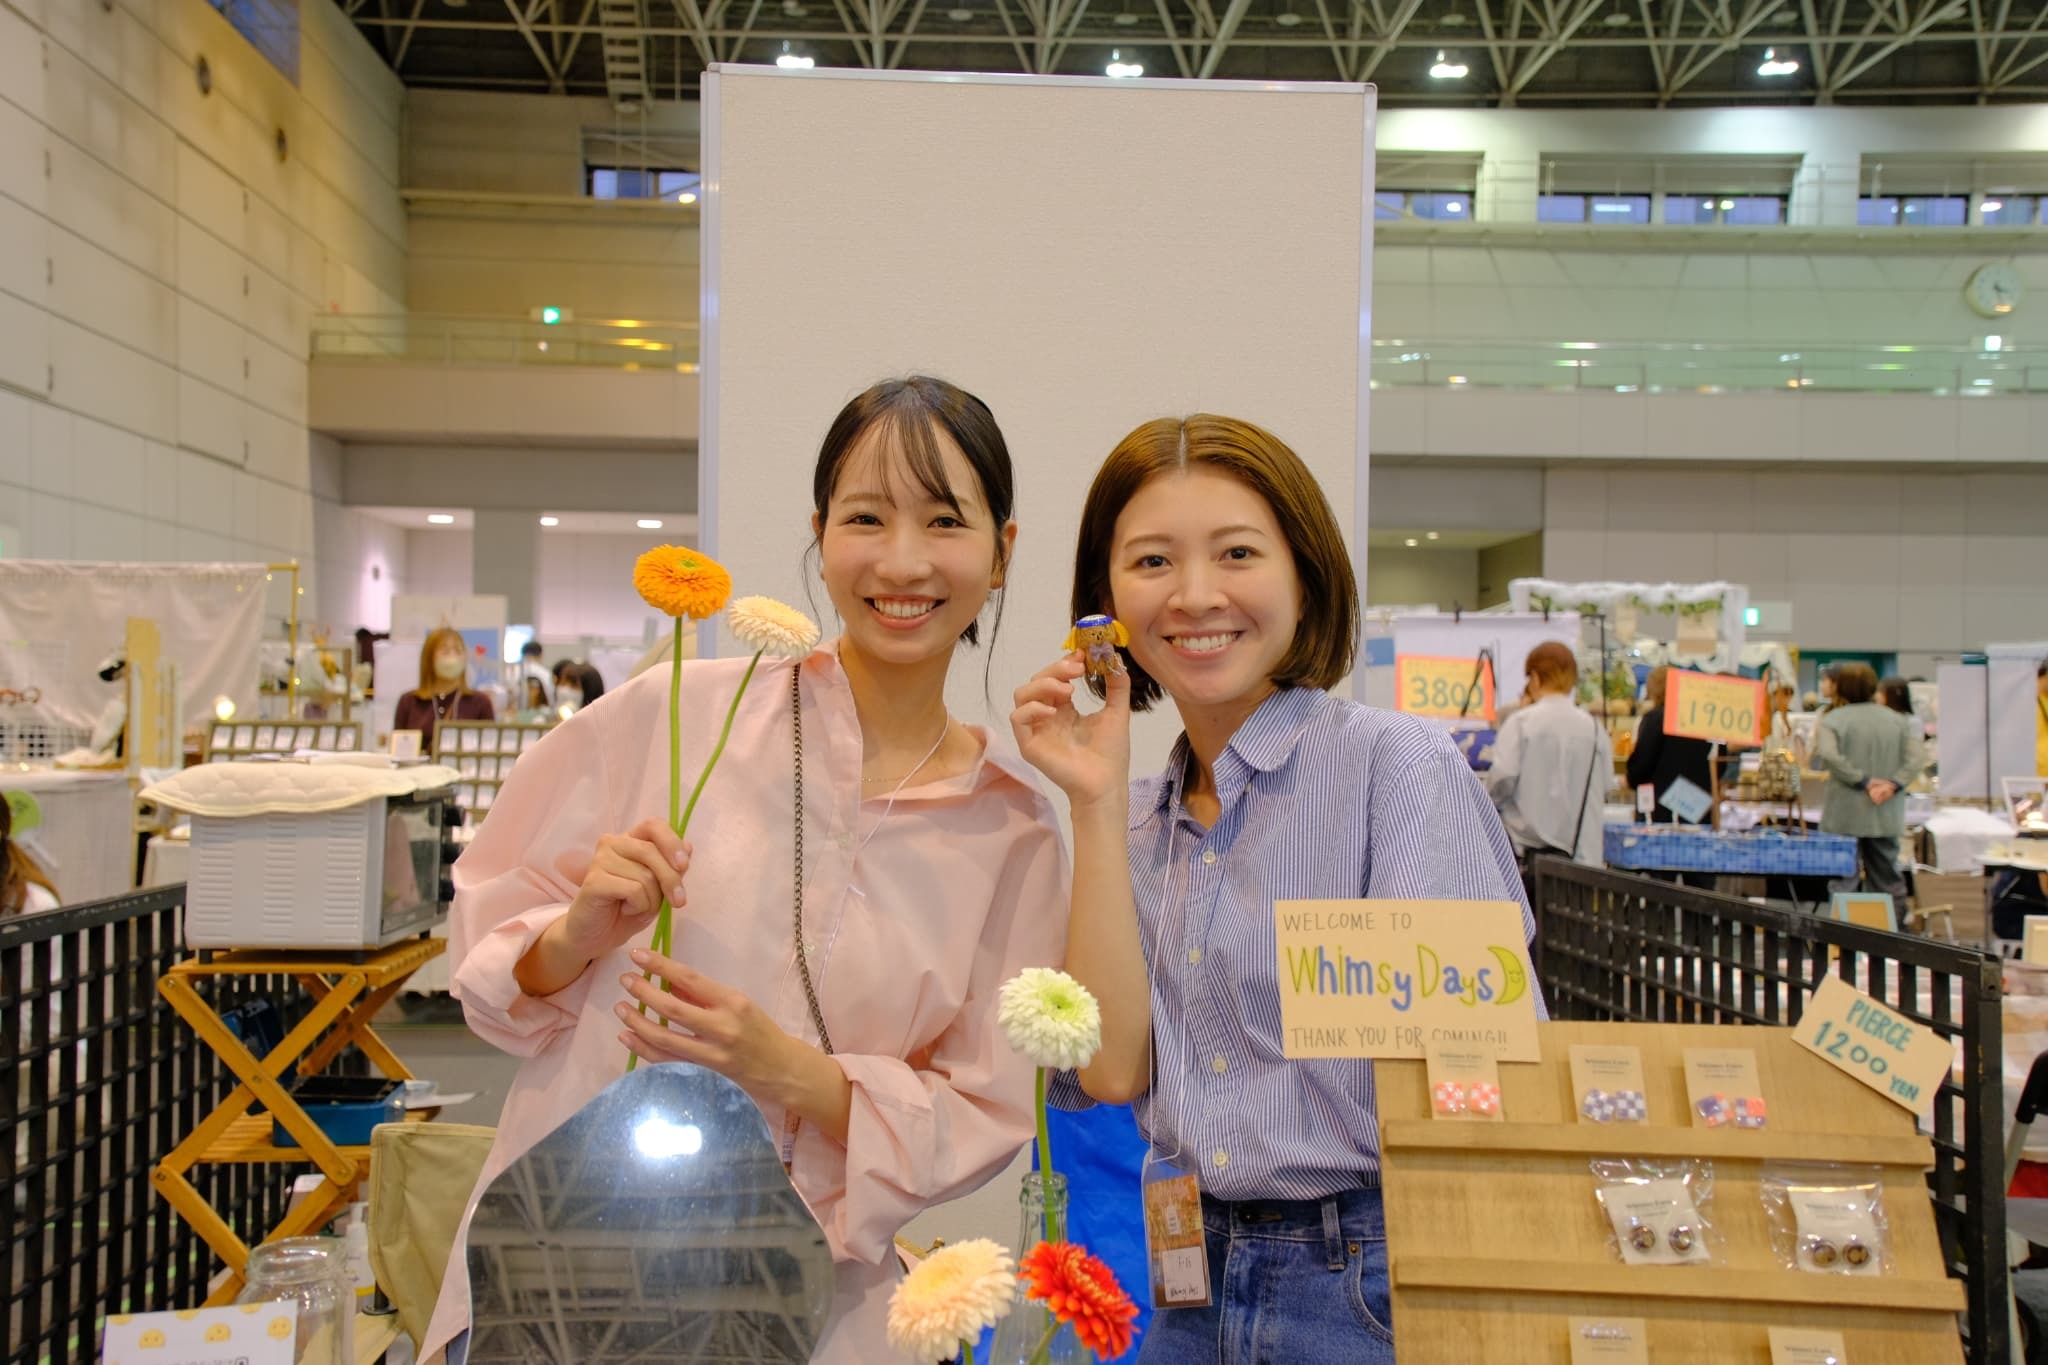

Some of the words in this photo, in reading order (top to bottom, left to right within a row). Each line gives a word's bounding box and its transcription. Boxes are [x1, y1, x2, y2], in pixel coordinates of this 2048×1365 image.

[1410, 675, 1484, 709] 3800
[1689, 699, 1753, 734] 1900
[1283, 912, 1376, 931] WELCOME
[1390, 912, 1412, 931] TO
[1286, 944, 1412, 1012] Whimsy
[1417, 943, 1494, 1007] Days
[1290, 1027, 1349, 1049] THANK
[1355, 1026, 1387, 1047] YOU
[1395, 1026, 1425, 1049] FOR
[1845, 999, 1914, 1053] PIERCE
[1813, 1020, 1888, 1076] 1200
[1889, 1075, 1920, 1102] YEN
